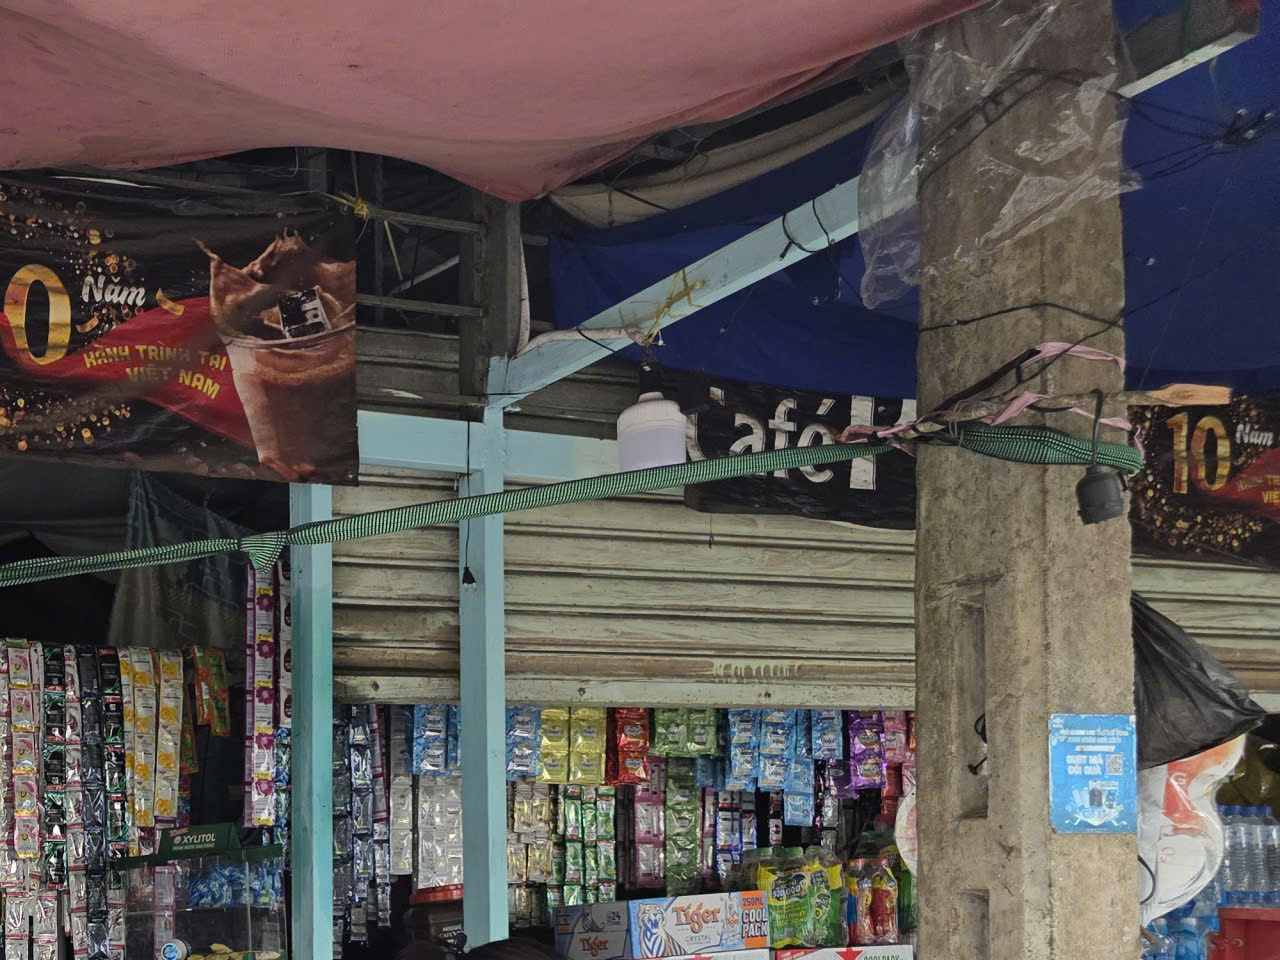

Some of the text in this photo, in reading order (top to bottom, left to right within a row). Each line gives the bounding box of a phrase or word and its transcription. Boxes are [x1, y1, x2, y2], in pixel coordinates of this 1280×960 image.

[81, 274, 147, 308] Năm
[178, 369, 221, 398] NAM
[1165, 410, 1232, 495] 10
[182, 833, 216, 846] XYLITOL
[742, 895, 765, 907] 250ML
[671, 900, 720, 934] Tiger
[741, 908, 768, 923] COOL
[685, 934, 712, 942] CRYSTAL
[741, 924, 768, 938] PACK
